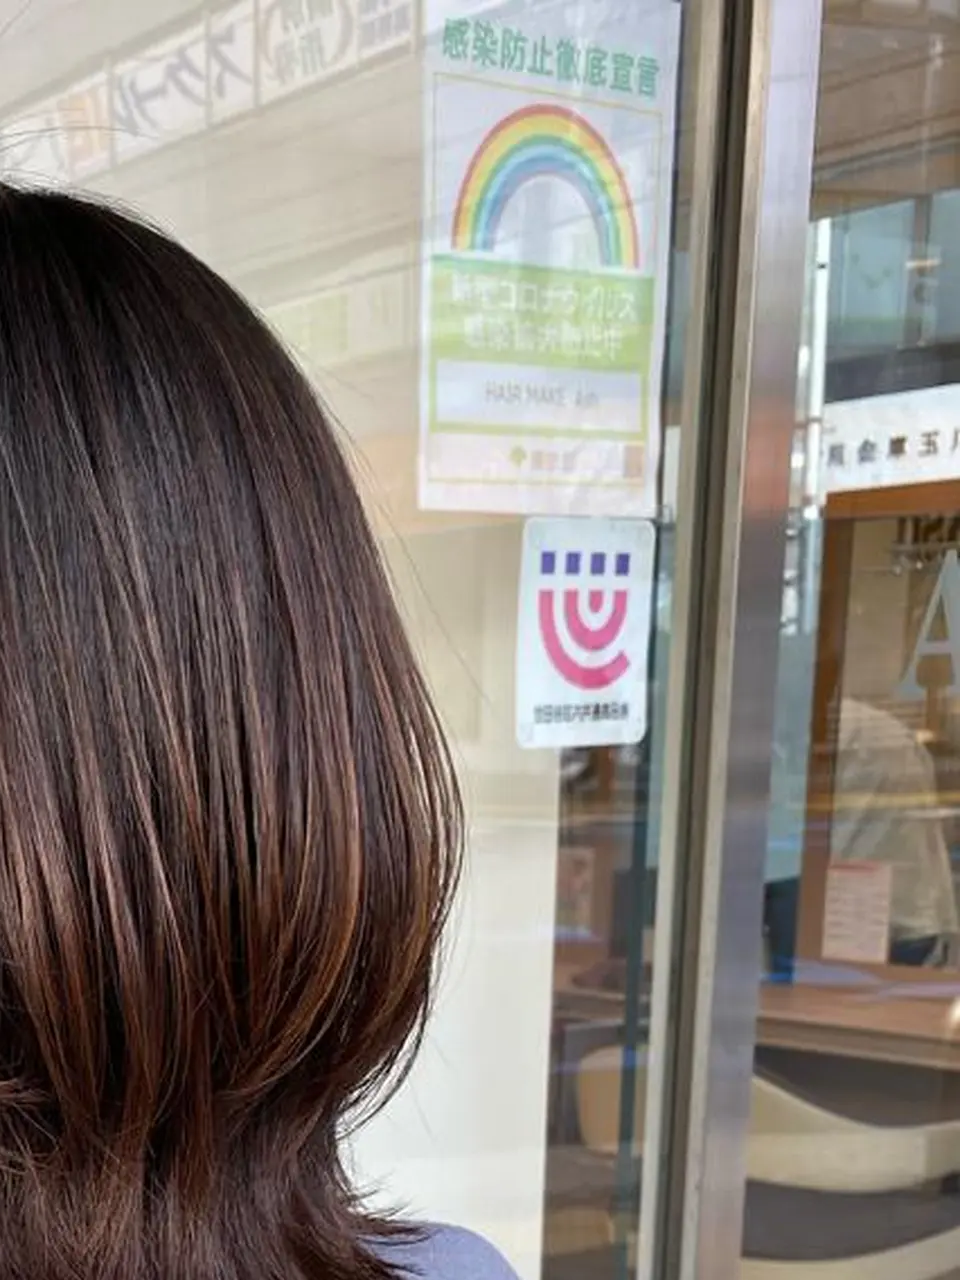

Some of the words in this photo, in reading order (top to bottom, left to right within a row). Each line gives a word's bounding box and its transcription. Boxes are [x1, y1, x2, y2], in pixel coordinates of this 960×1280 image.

[443, 17, 660, 97] 感染防止徹底宣言
